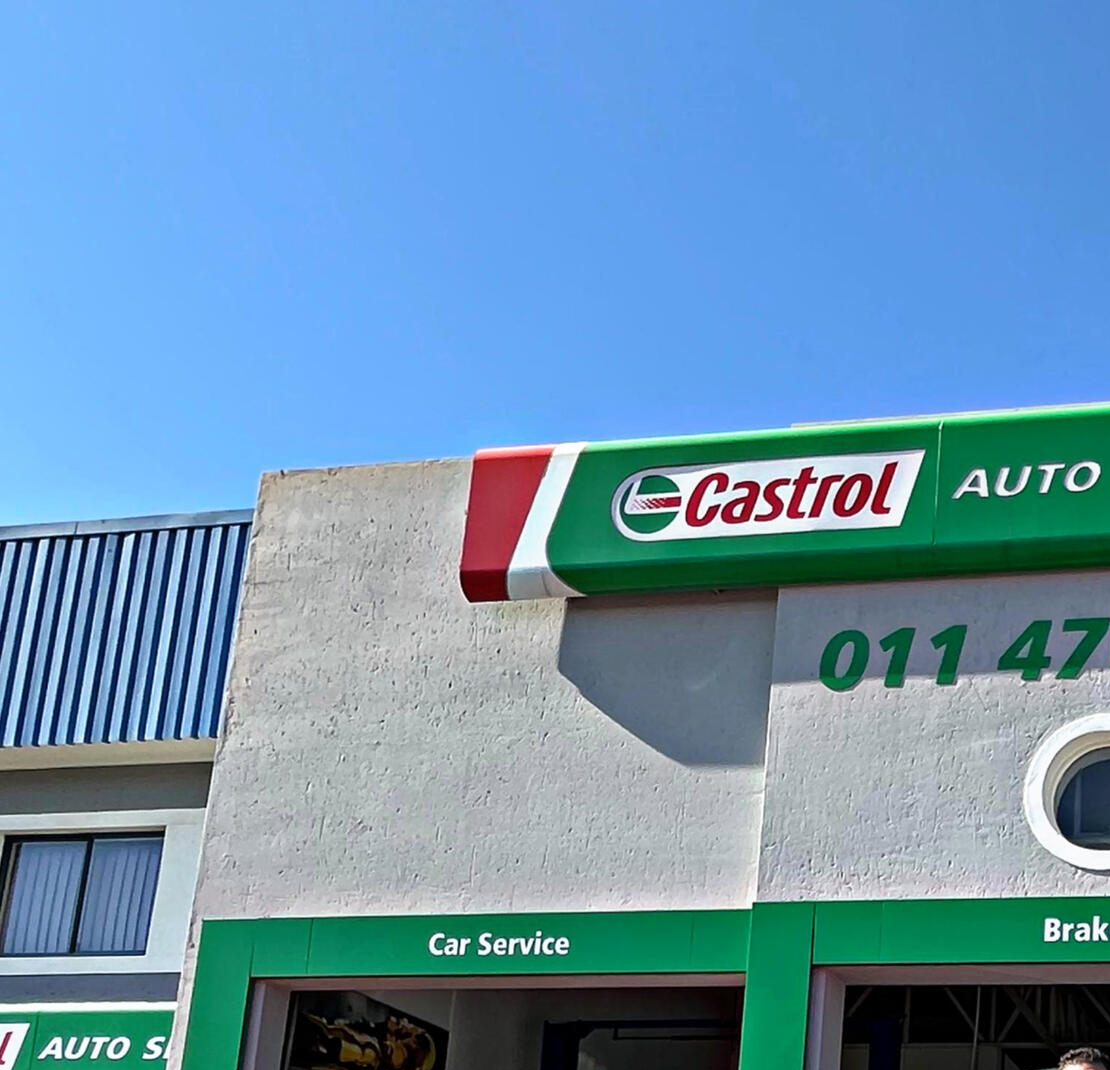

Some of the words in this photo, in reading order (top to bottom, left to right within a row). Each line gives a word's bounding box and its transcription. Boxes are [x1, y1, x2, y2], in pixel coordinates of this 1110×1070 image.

[684, 461, 899, 527] Castrol
[952, 460, 1101, 499] AUTO
[819, 624, 967, 691] 011
[428, 932, 471, 955] Car
[477, 930, 570, 955] Service
[37, 1036, 131, 1060] AUTO
[142, 1036, 171, 1060] S
